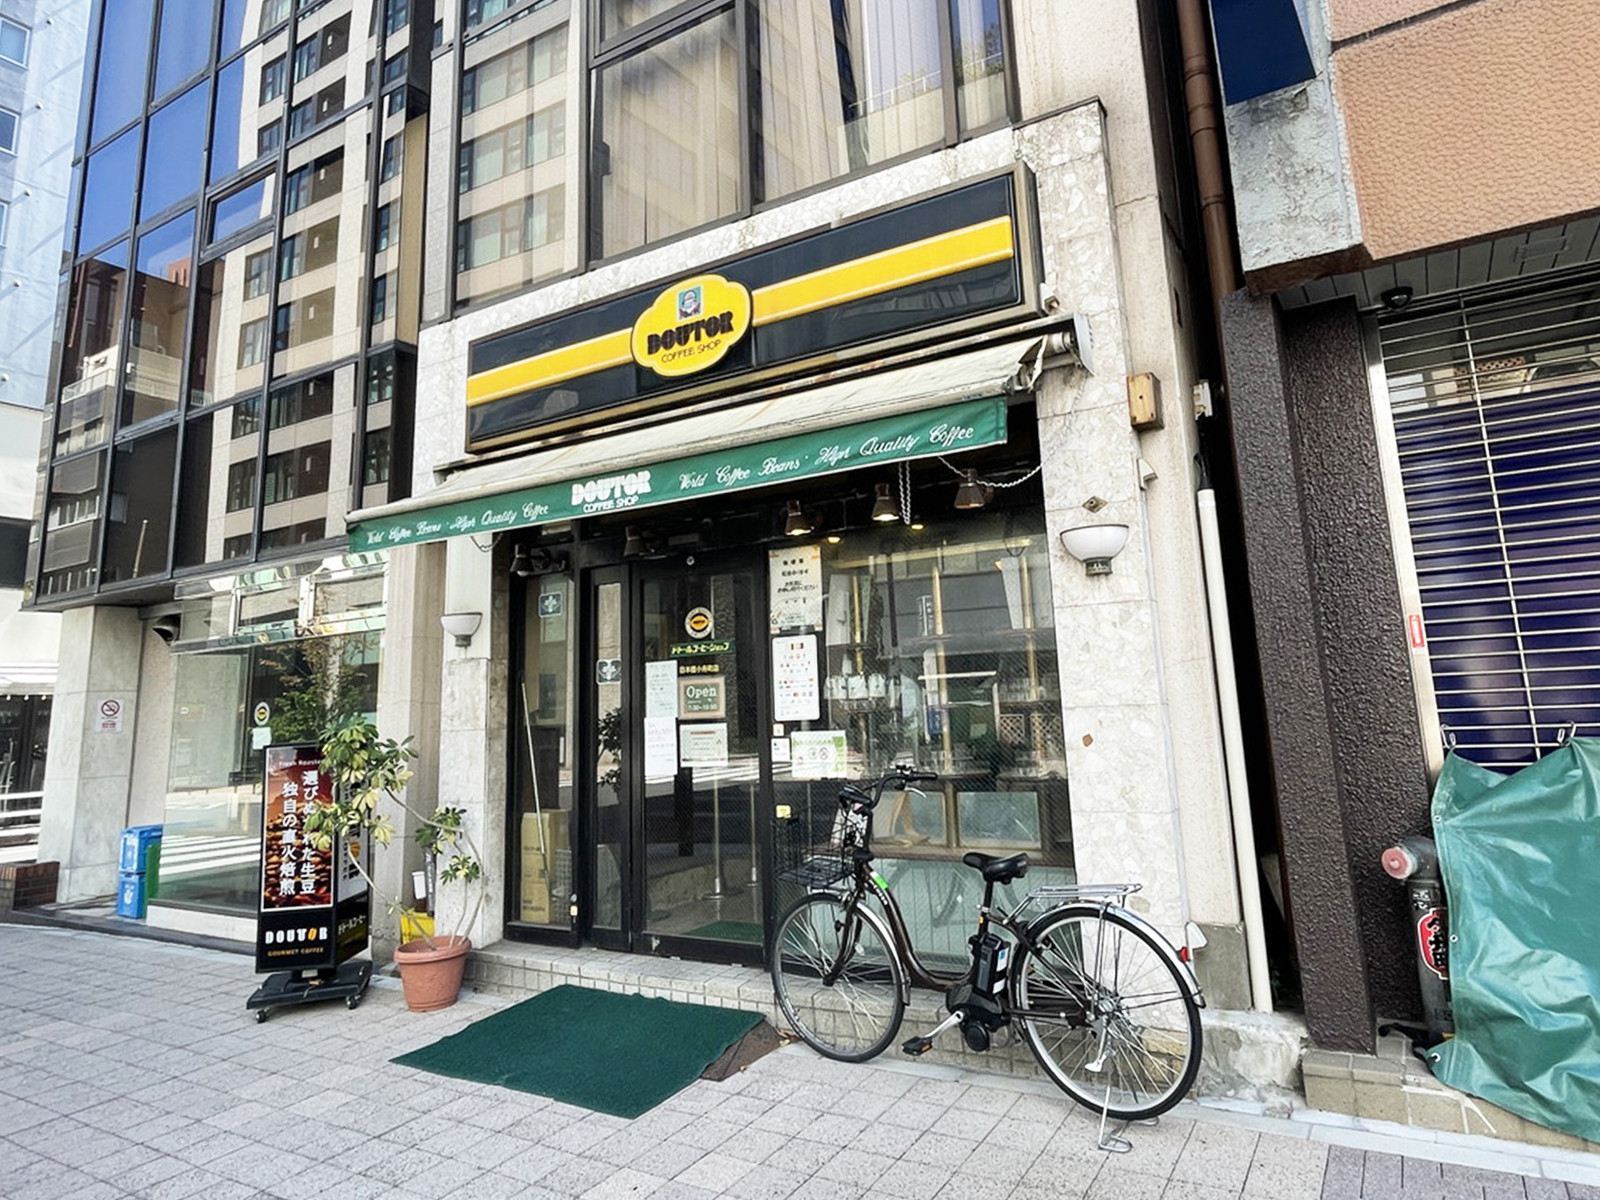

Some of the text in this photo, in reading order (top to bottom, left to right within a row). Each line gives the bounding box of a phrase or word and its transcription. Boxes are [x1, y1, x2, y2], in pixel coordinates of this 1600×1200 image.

[647, 311, 734, 355] DOUTOR
[661, 339, 721, 363] COFFEE SHOP
[679, 424, 974, 490] World Coffee Beans High Quality Coffee
[571, 470, 651, 505] DOUTOR
[481, 509, 517, 525] Quality
[522, 502, 549, 521] Coffee
[583, 496, 639, 513] COFFEE SHOP
[687, 686, 717, 698] Open
[279, 781, 299, 897] 独自の直火焙煎
[300, 770, 319, 895] 選びぬれた生豆
[265, 927, 328, 945] DOUTOR
